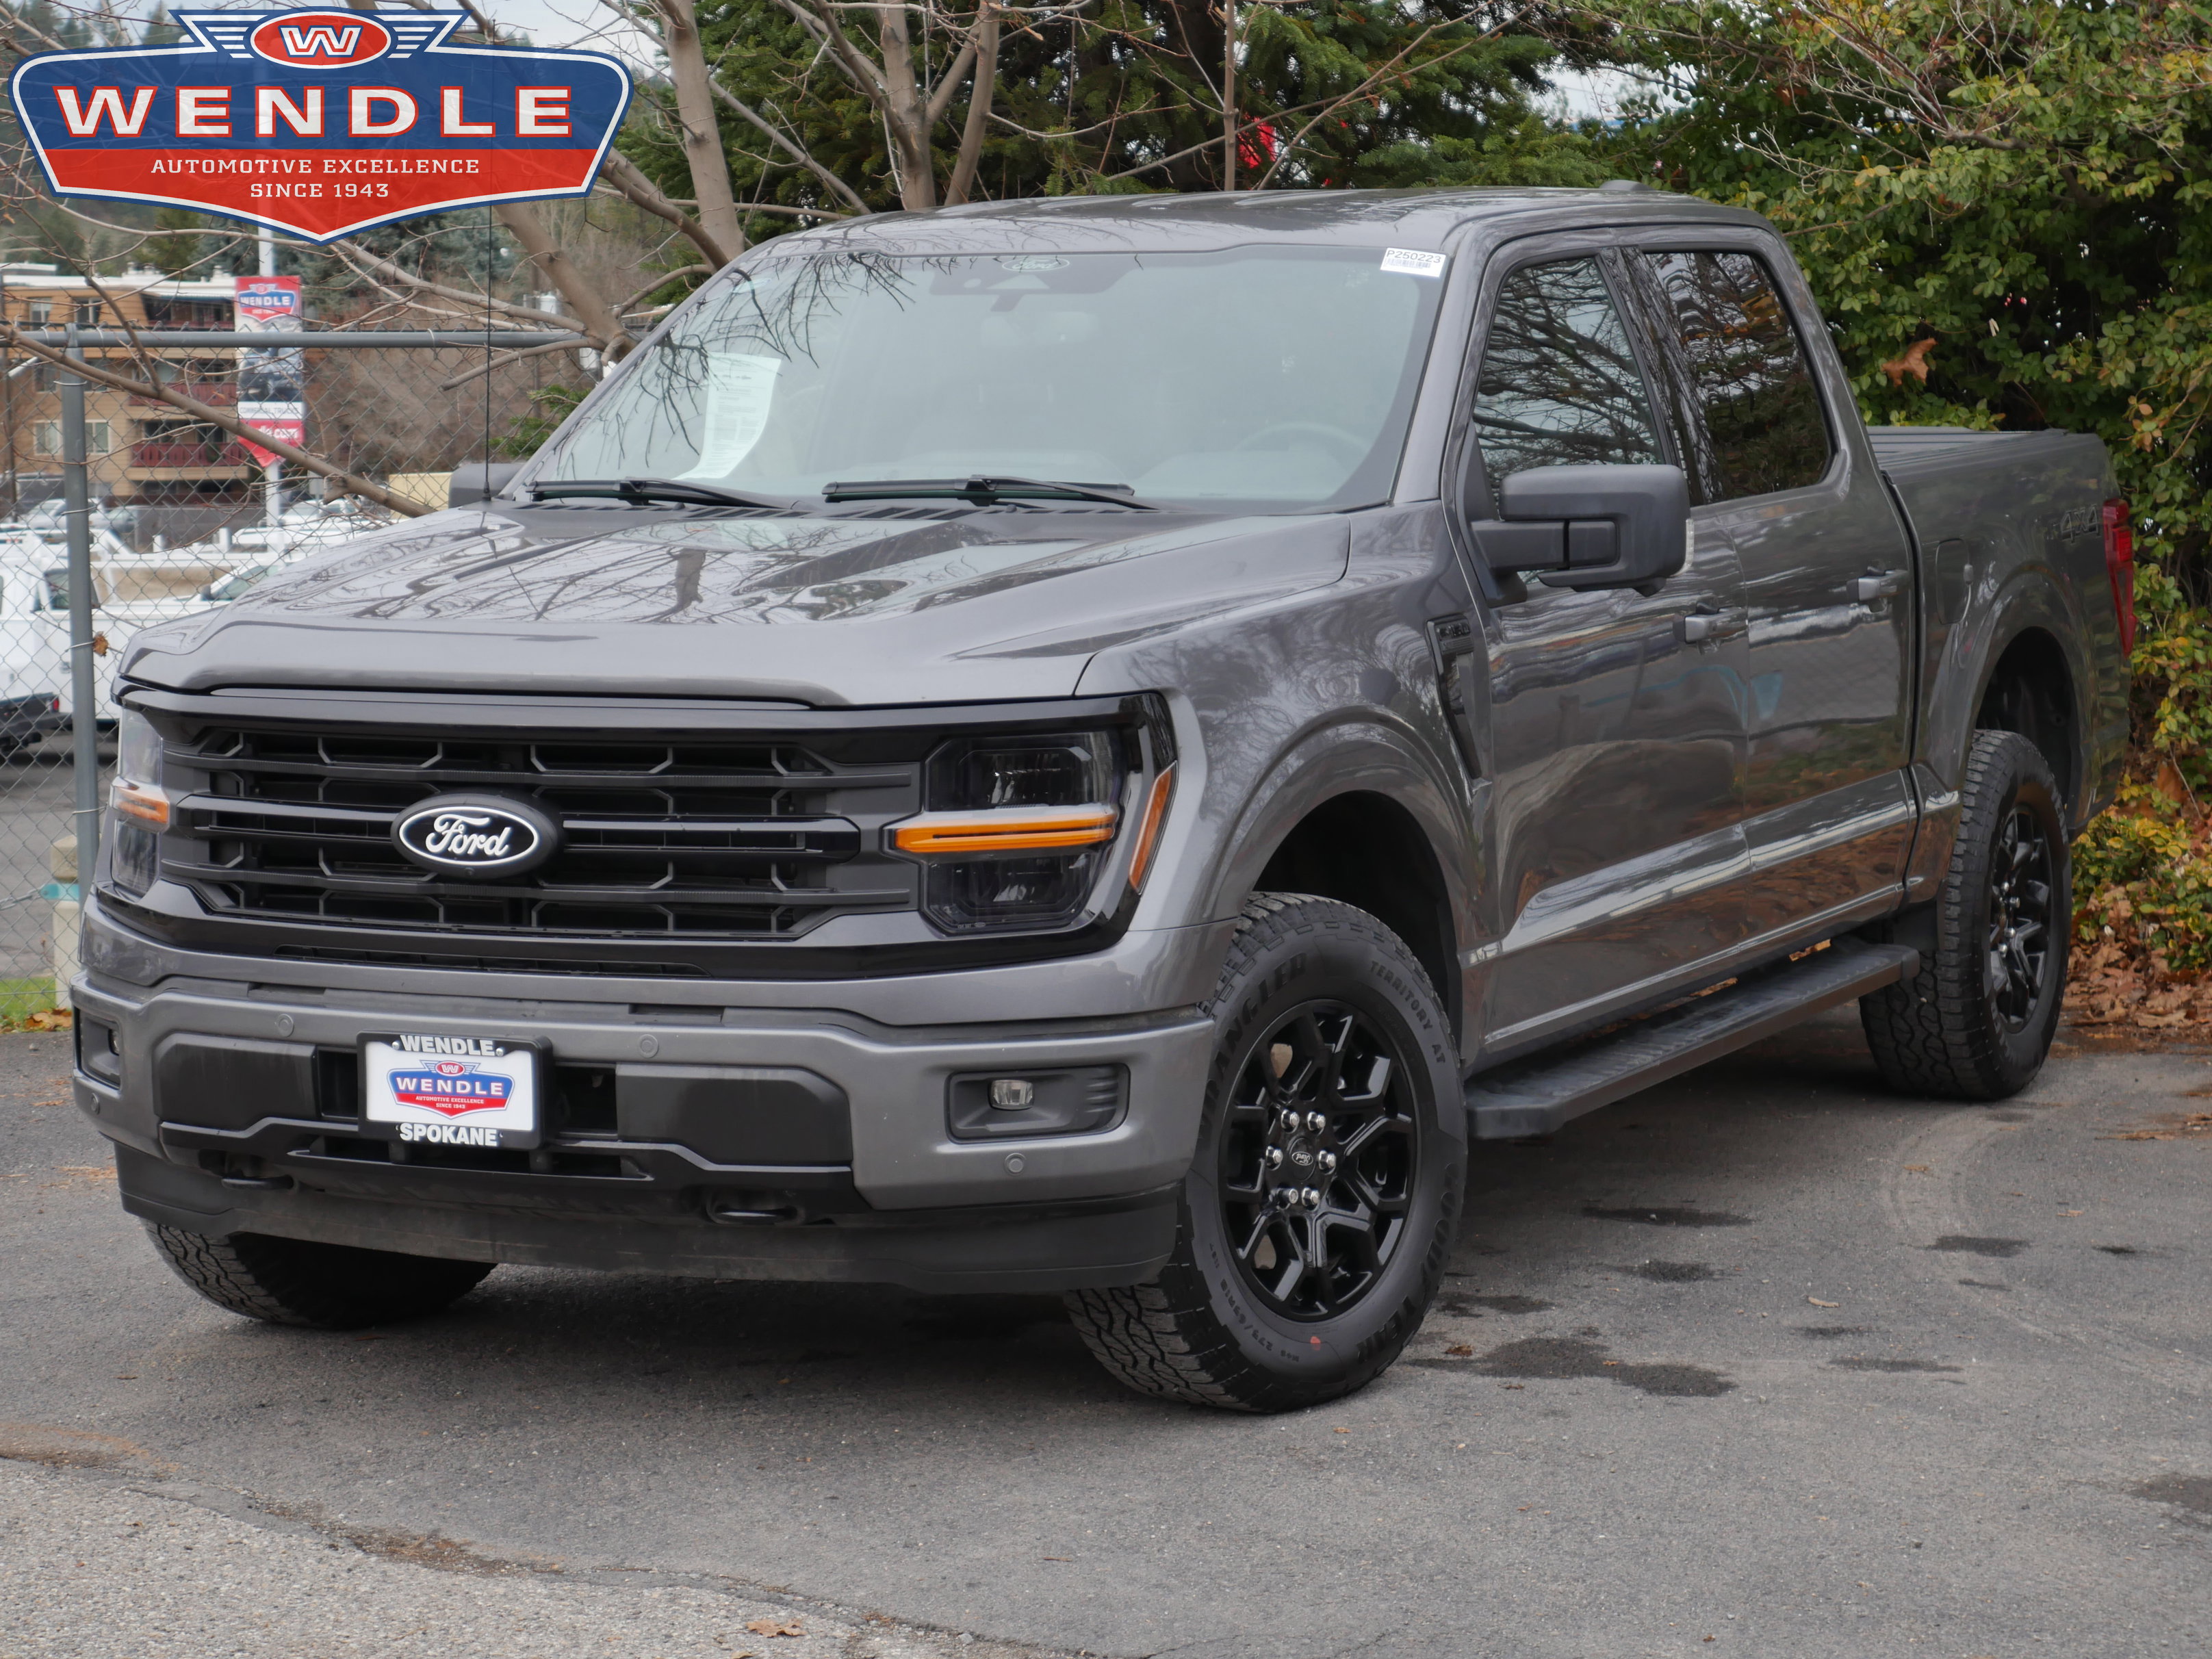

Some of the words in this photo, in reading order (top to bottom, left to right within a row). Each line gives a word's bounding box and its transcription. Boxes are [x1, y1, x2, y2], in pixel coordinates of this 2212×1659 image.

[1387, 250, 1441, 263] P250223
[240, 296, 291, 307] WENDLE
[426, 814, 512, 856] Ford
[1369, 961, 1433, 1030] TERRITORY
[1432, 1044, 1445, 1063] AT
[400, 1035, 496, 1057] WENDLE
[396, 1077, 503, 1096] WENDLE
[400, 1122, 498, 1146] SPOKANE
